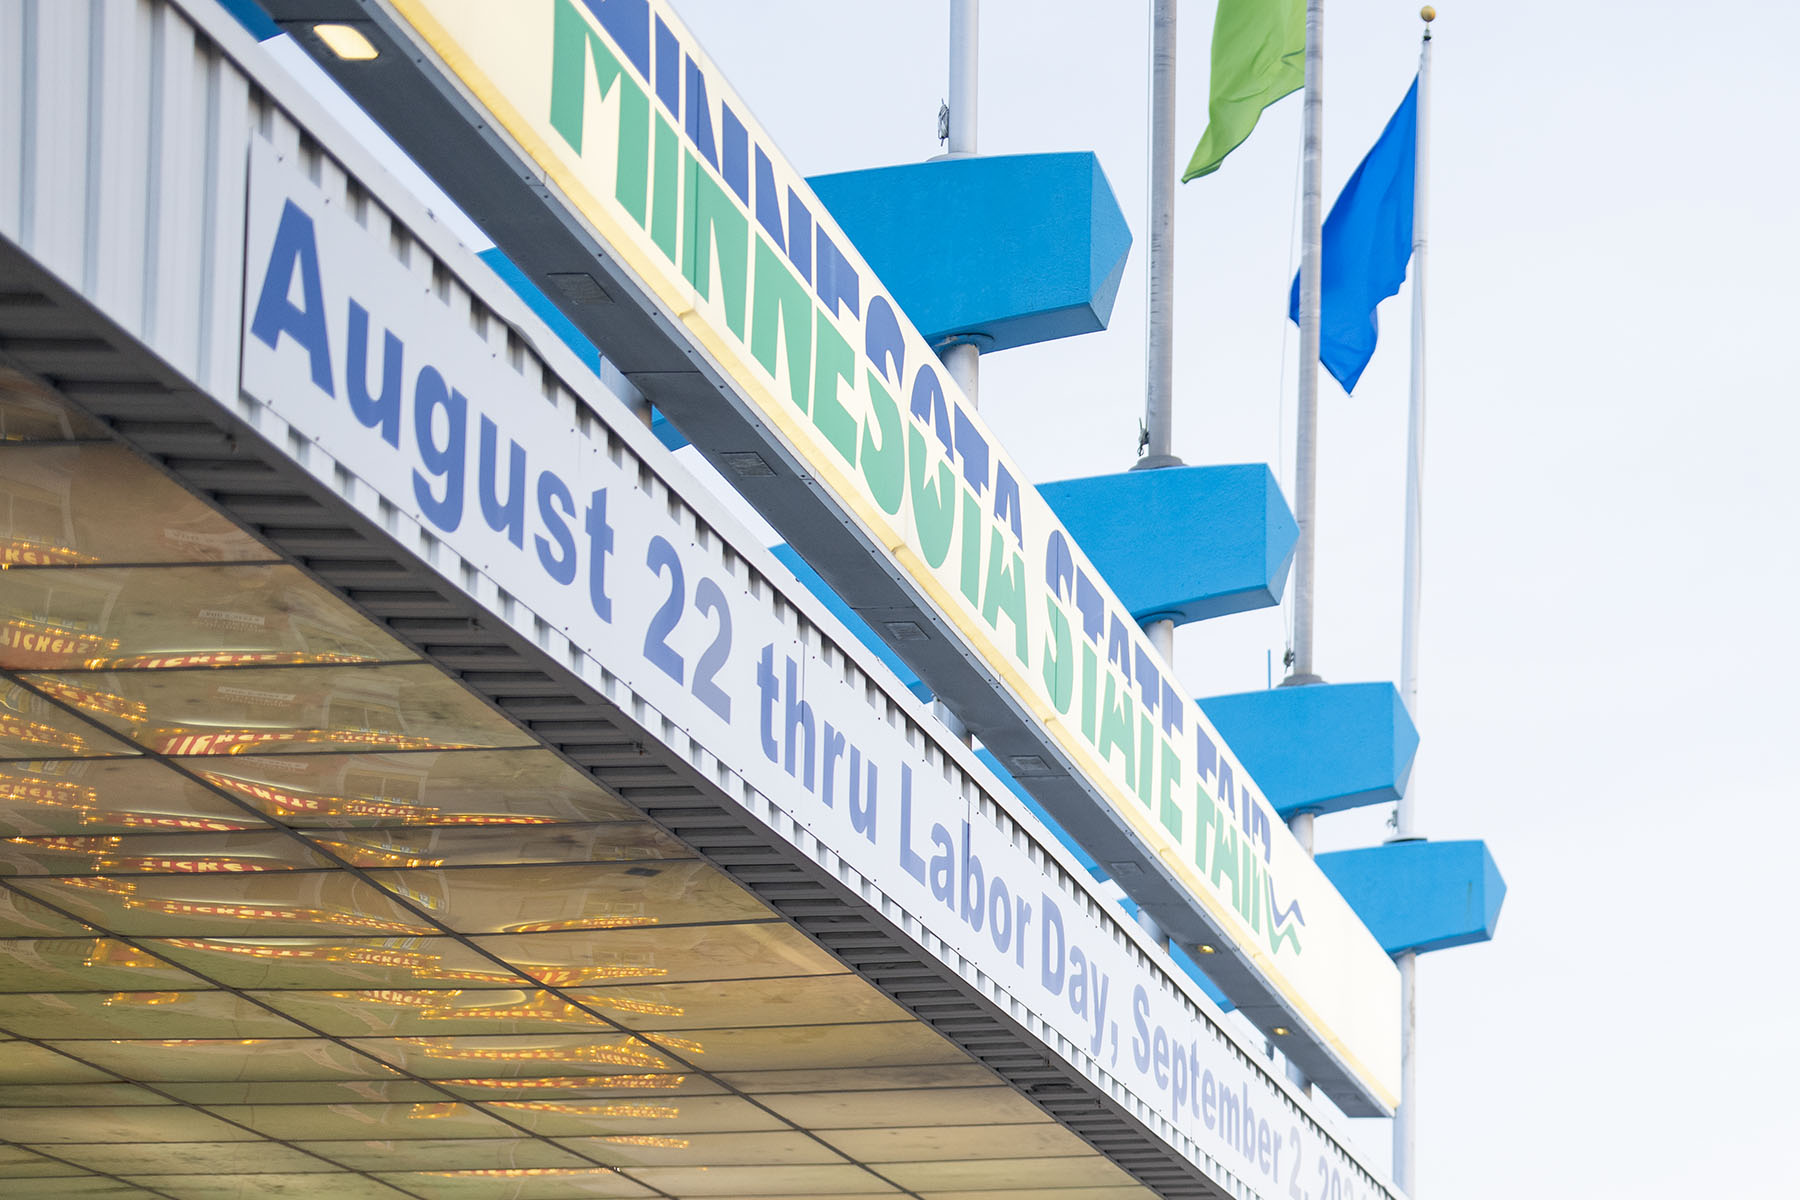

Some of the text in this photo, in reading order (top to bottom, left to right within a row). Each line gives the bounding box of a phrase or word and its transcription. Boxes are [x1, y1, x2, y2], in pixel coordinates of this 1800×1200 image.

[251, 197, 614, 625] August
[643, 535, 733, 725] 22
[756, 642, 878, 845] thru
[899, 760, 1032, 969] Labor
[1041, 892, 1119, 1068] Day,
[1131, 983, 1283, 1184] September
[1043, 529, 1183, 846] STATE
[1196, 722, 1306, 956] FAIR
